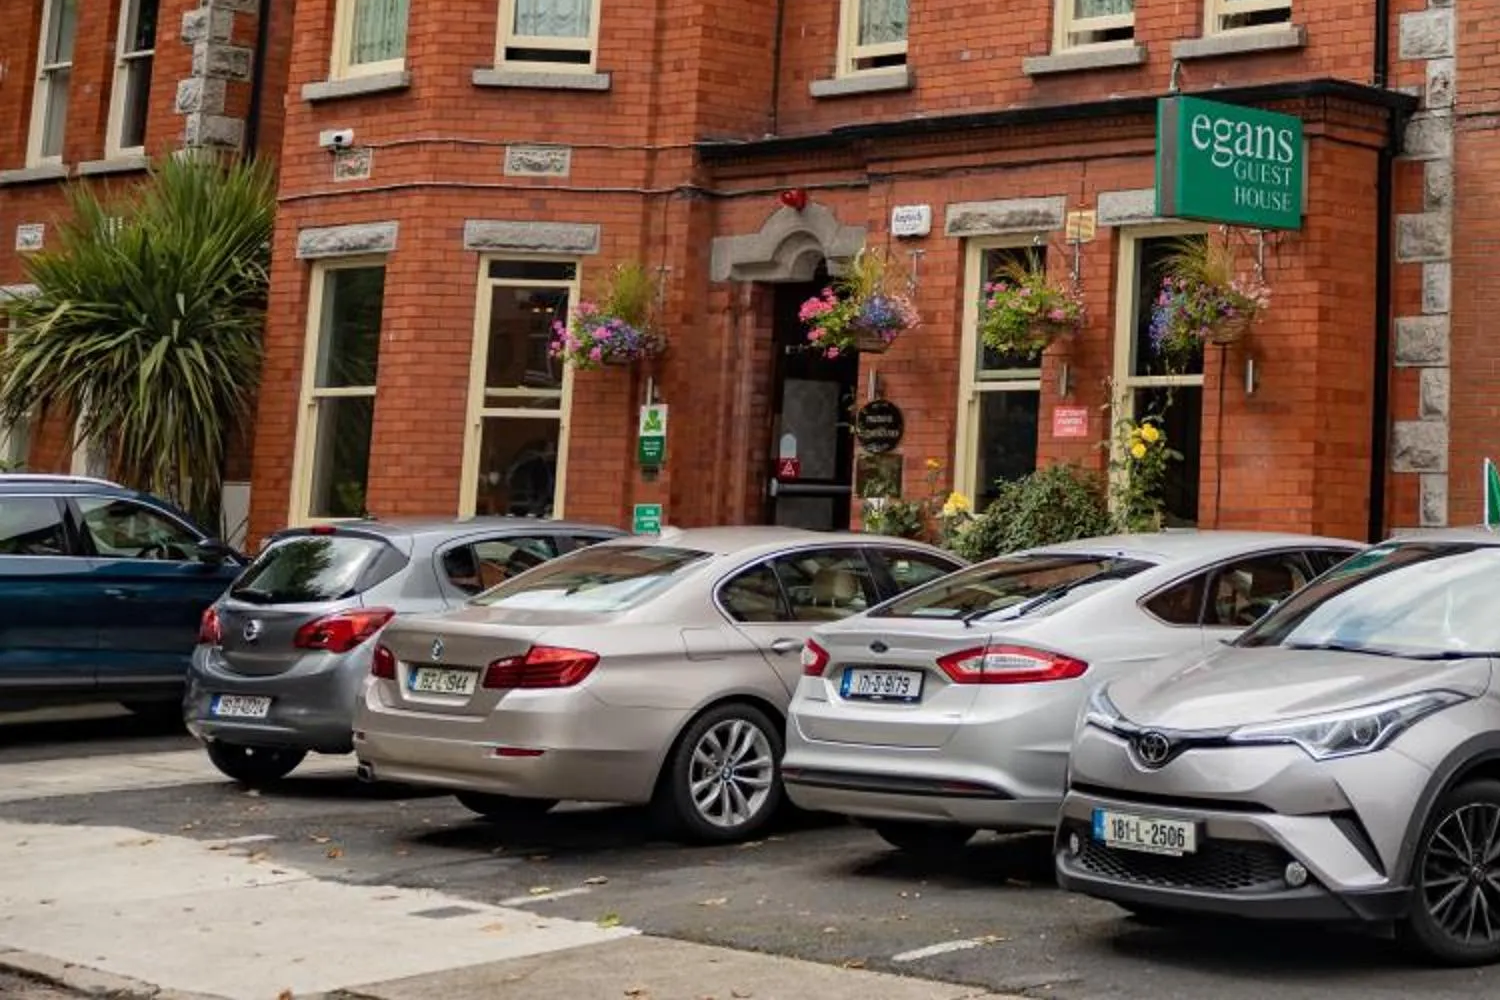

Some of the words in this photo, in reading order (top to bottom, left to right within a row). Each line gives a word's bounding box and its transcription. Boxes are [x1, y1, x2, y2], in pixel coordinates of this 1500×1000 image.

[1191, 113, 1294, 168] egans
[1233, 159, 1293, 187] GUEST
[1233, 184, 1293, 213] HOUSE
[1111, 818, 1185, 848] 181-L-2506
